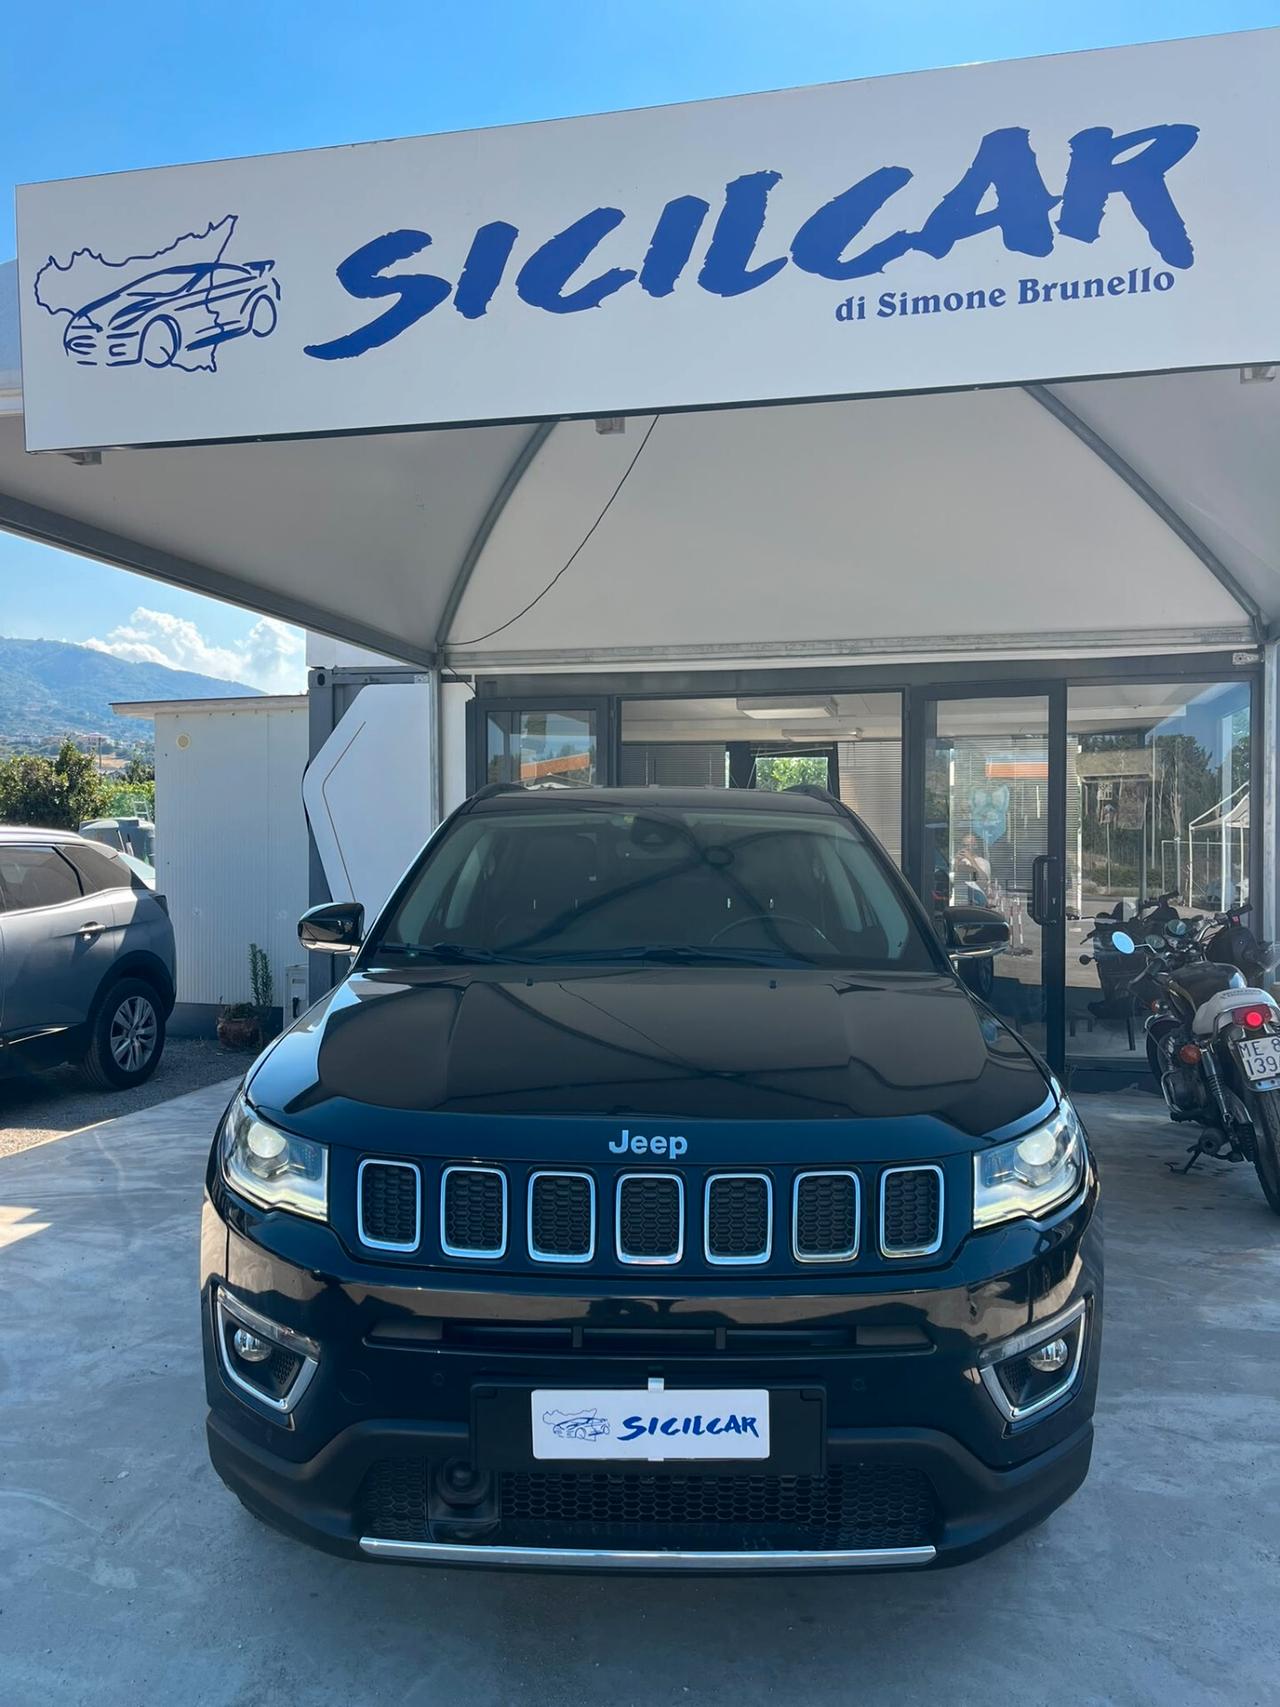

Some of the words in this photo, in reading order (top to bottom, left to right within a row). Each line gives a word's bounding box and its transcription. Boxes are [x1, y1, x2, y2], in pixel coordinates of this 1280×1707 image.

[304, 123, 1200, 361] SICILCAR
[836, 297, 866, 322] di
[877, 288, 1006, 317] Simone
[1018, 266, 1175, 304] Brunello
[1239, 1041, 1264, 1057] ME
[609, 1130, 688, 1159] Jeep
[617, 1415, 759, 1441] SICILCAR
